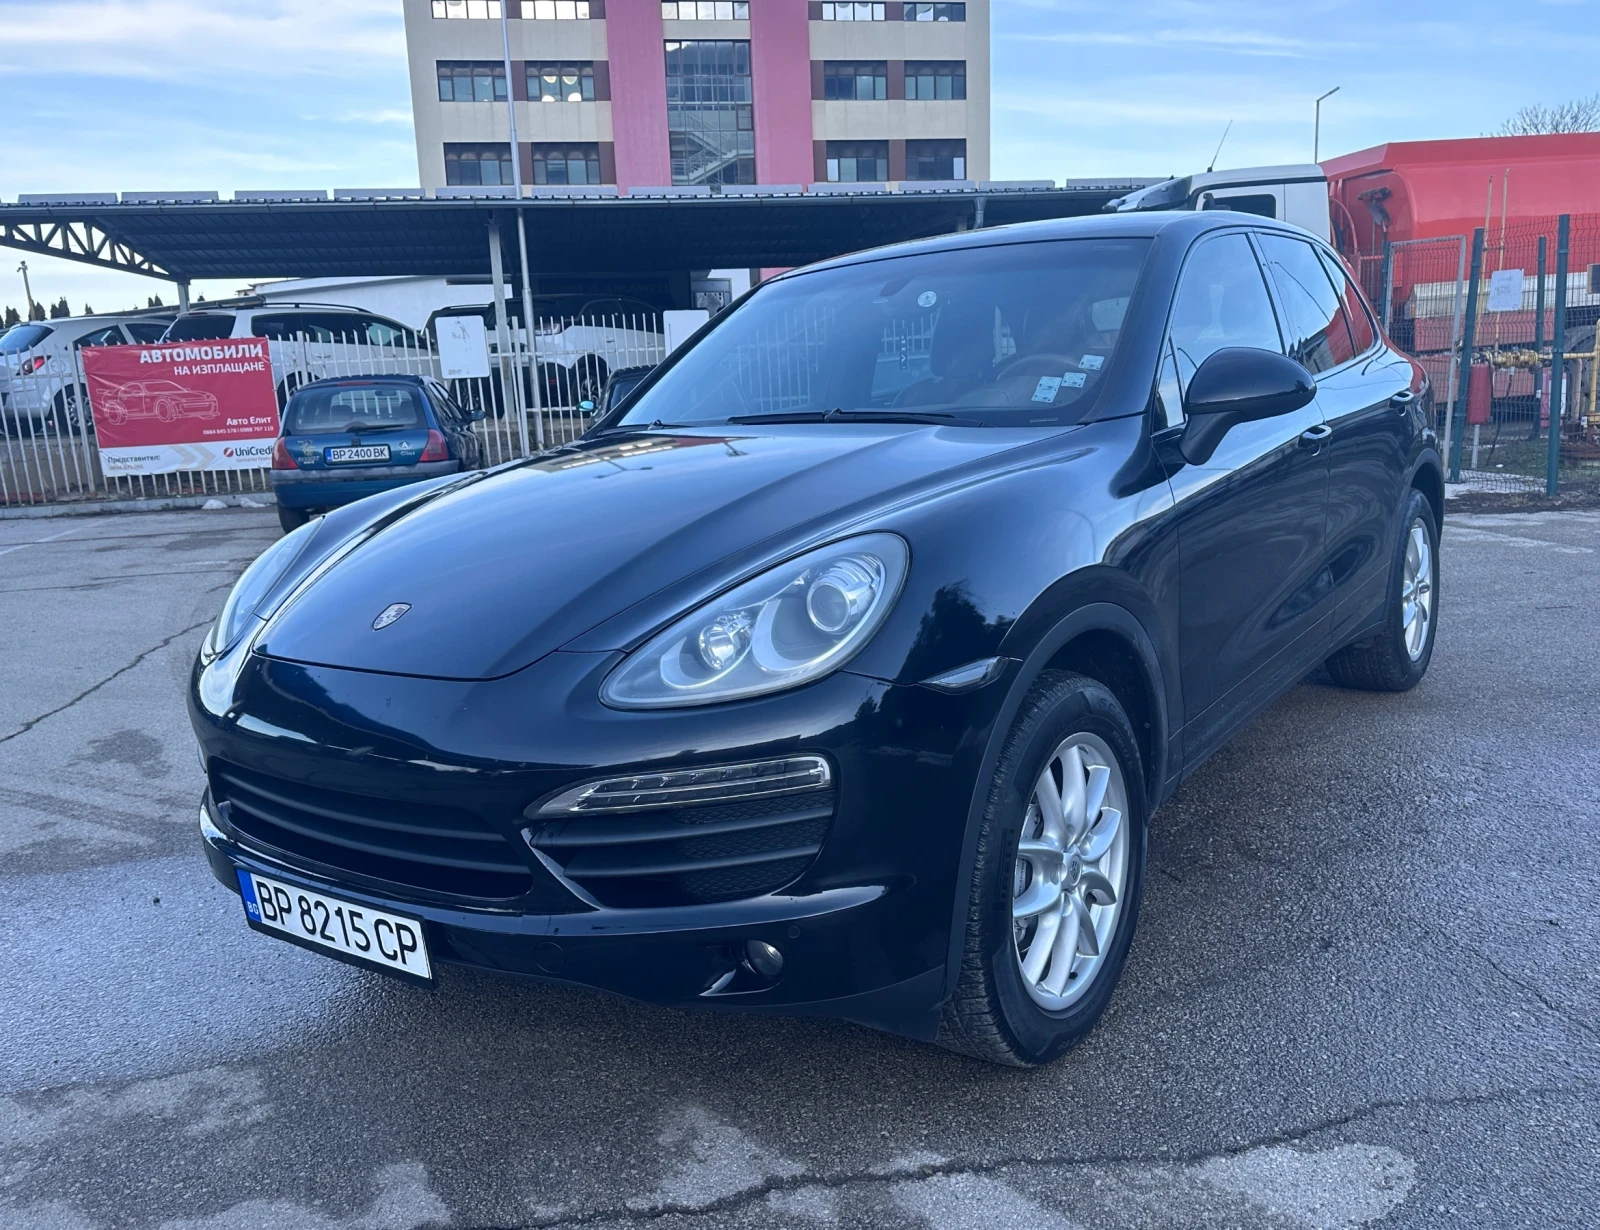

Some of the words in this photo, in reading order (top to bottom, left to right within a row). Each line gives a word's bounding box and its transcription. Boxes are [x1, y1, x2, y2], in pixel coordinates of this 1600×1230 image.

[140, 344, 263, 363] АВТОМОБИЛИ
[174, 366, 190, 376] НА
[192, 361, 265, 375] ИЗПЛАЩАНЕ
[226, 417, 248, 426] Авто
[250, 415, 272, 425] Елит
[235, 445, 274, 457] UniCredi
[332, 449, 346, 460] BP
[347, 448, 372, 459] 2400
[373, 447, 387, 458] BK
[107, 455, 161, 464] Представител:
[247, 901, 259, 915] BG
[256, 880, 292, 925] BP
[298, 895, 371, 952] 8215
[374, 918, 418, 965] CP
